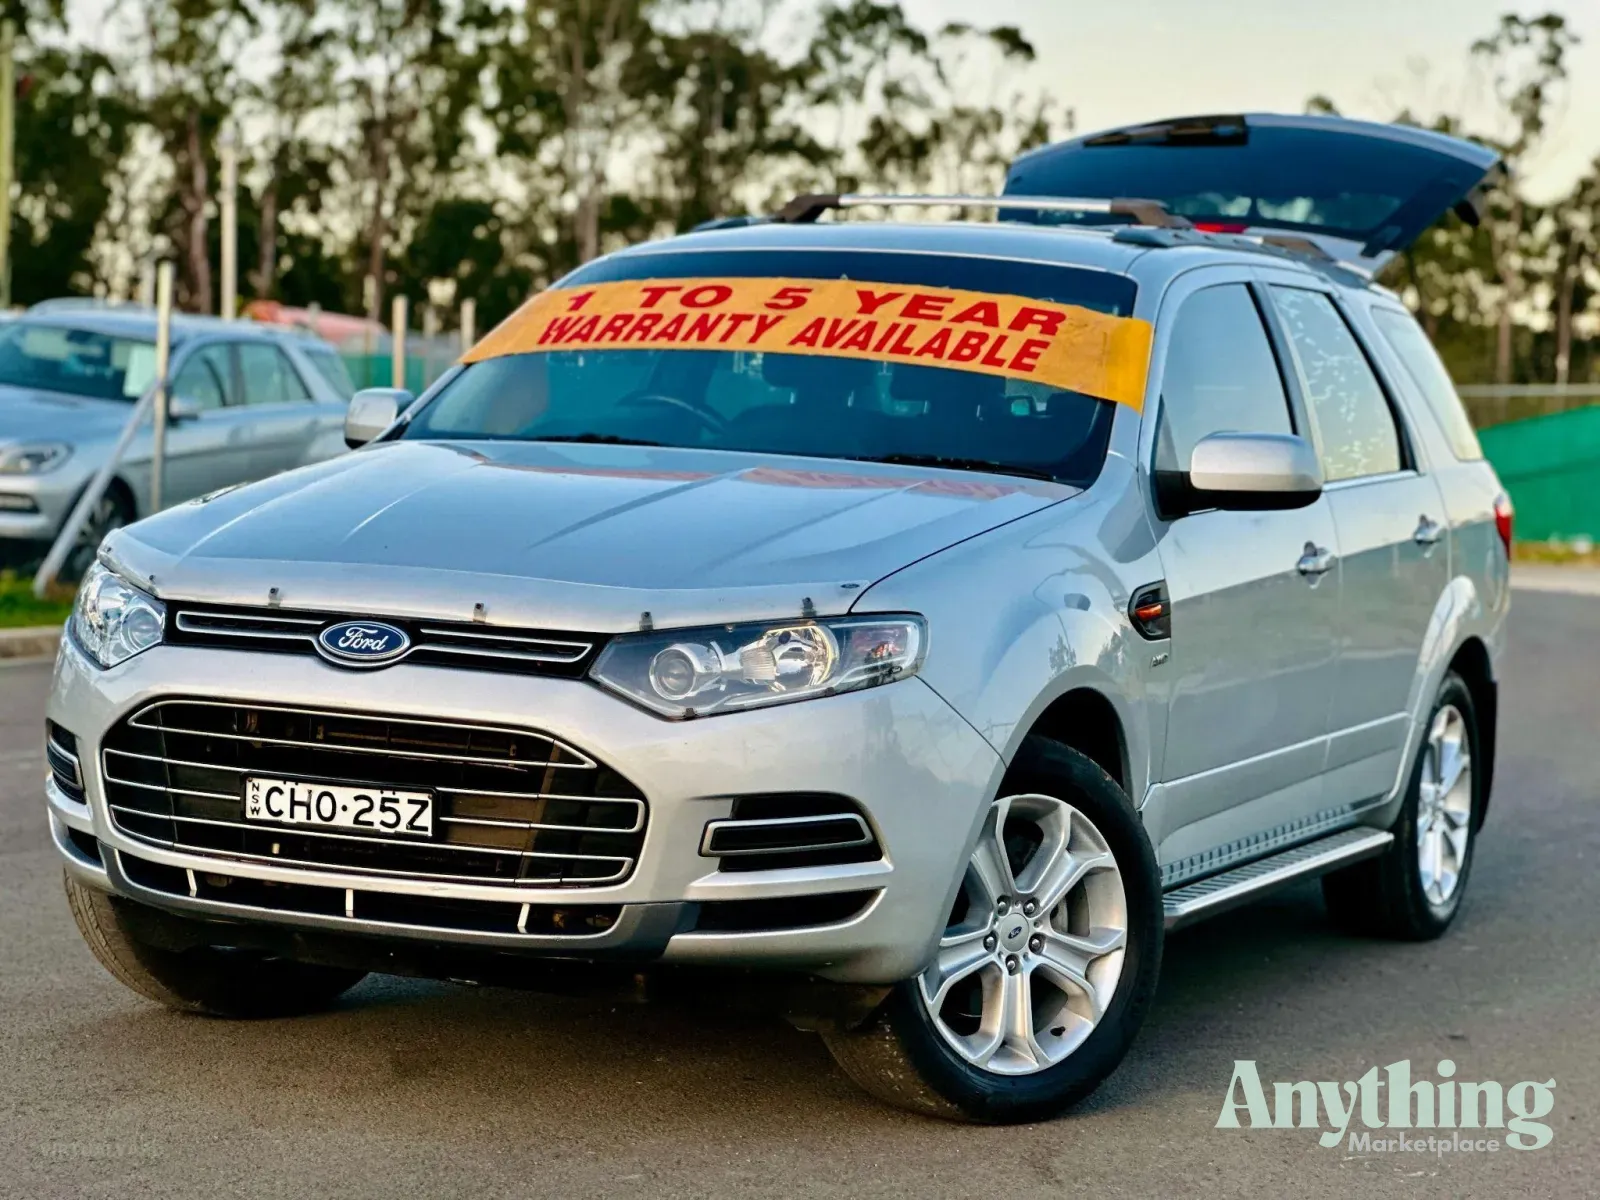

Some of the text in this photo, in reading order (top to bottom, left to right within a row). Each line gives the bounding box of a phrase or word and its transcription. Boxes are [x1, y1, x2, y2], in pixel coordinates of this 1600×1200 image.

[568, 285, 1067, 337] 1 TO 5 YEAR
[537, 313, 1051, 373] WARRANTY AVAILABLE
[338, 626, 389, 651] Ford
